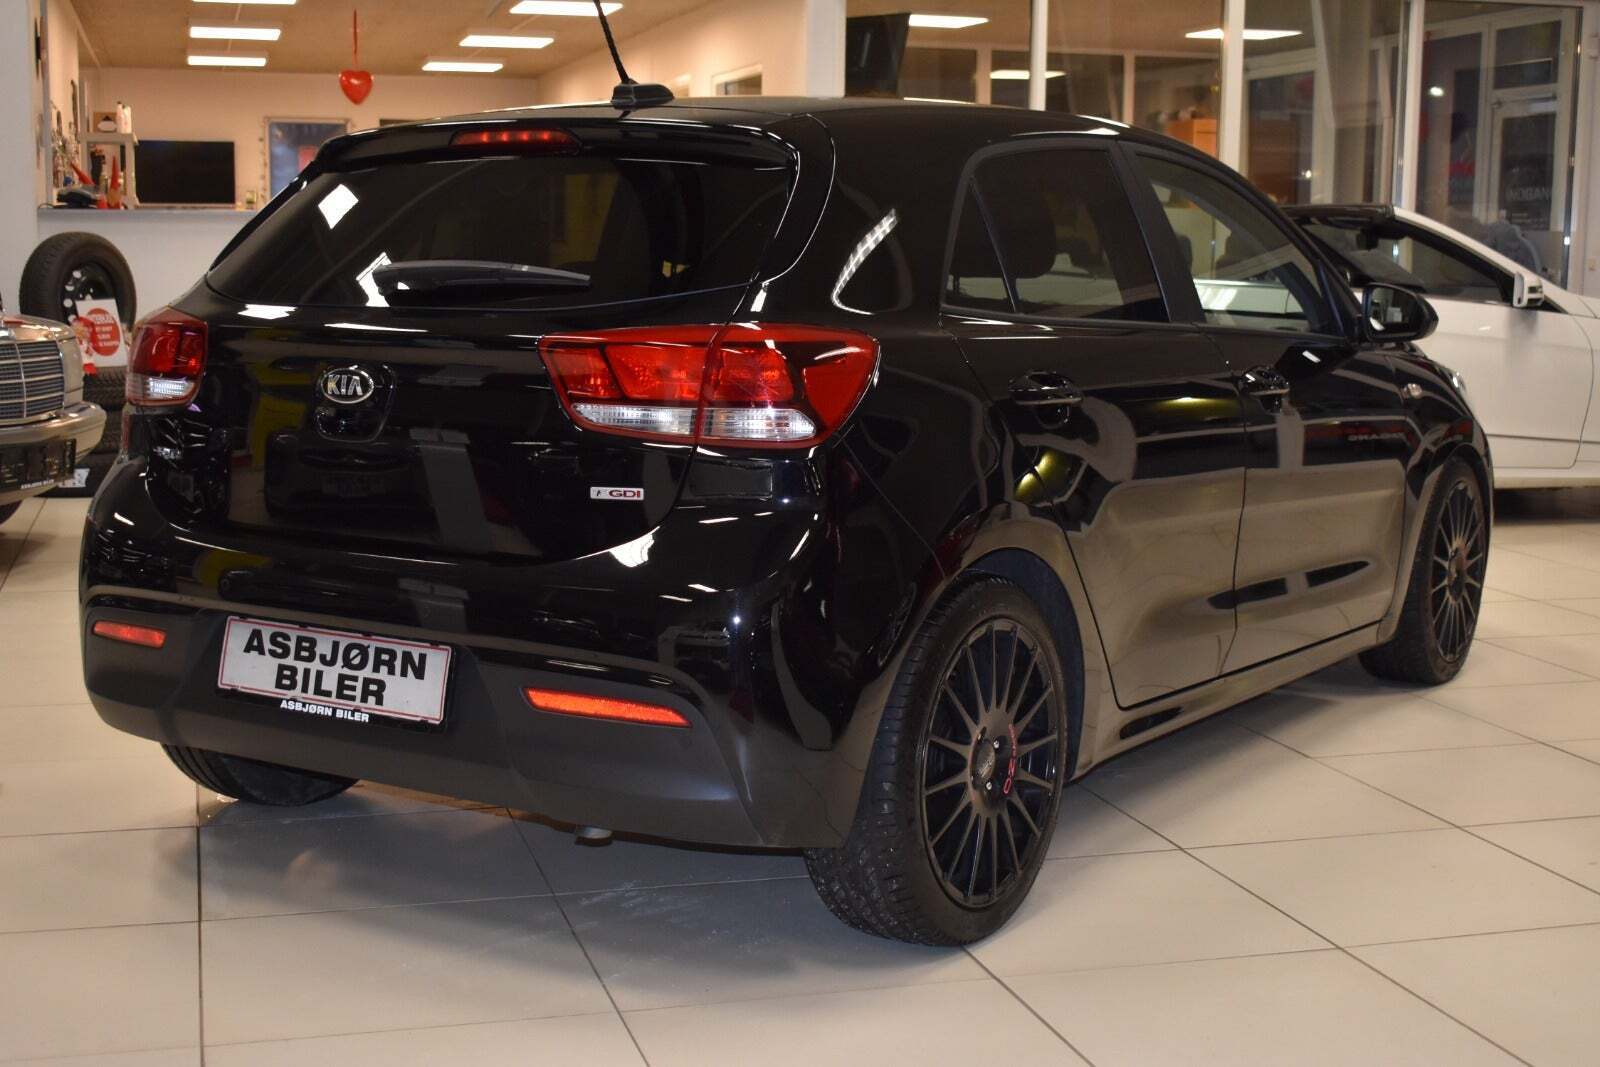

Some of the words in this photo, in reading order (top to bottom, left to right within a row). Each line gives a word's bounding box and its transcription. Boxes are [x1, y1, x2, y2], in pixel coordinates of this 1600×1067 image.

[327, 374, 364, 396] KIA
[243, 628, 427, 680] ASBJØRN
[274, 663, 387, 706] BILER
[280, 699, 333, 719] ASBJØRN
[335, 708, 370, 723] BILER
